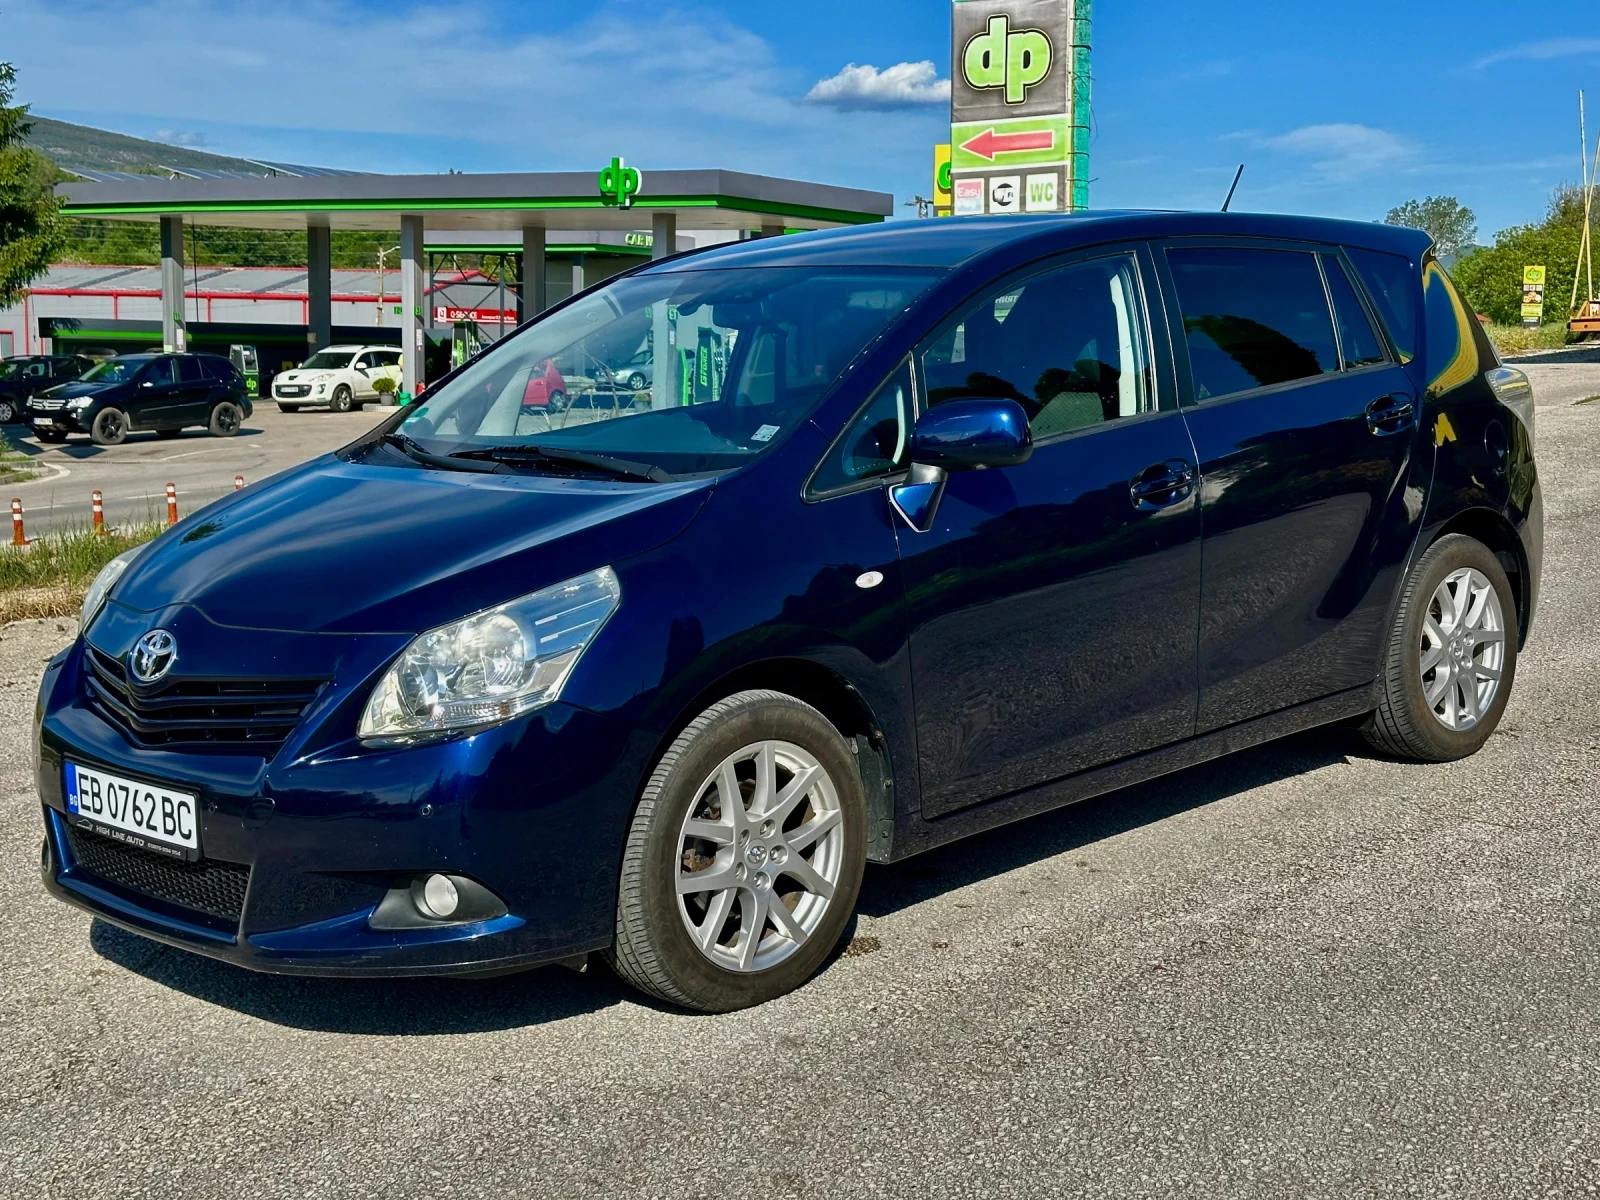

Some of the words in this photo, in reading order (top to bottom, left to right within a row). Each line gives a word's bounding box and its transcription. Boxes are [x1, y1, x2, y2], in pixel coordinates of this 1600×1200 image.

[962, 13, 1053, 105] dp
[599, 157, 641, 206] dp
[957, 186, 981, 198] Easy
[1030, 182, 1053, 202] WC
[246, 378, 257, 390] dp
[70, 794, 78, 806] BG
[78, 772, 103, 815] EB
[107, 782, 158, 832] 0762
[161, 795, 192, 840] BC
[96, 825, 110, 836] HIGH
[112, 830, 125, 841] LINE
[126, 835, 145, 847] AUTO
